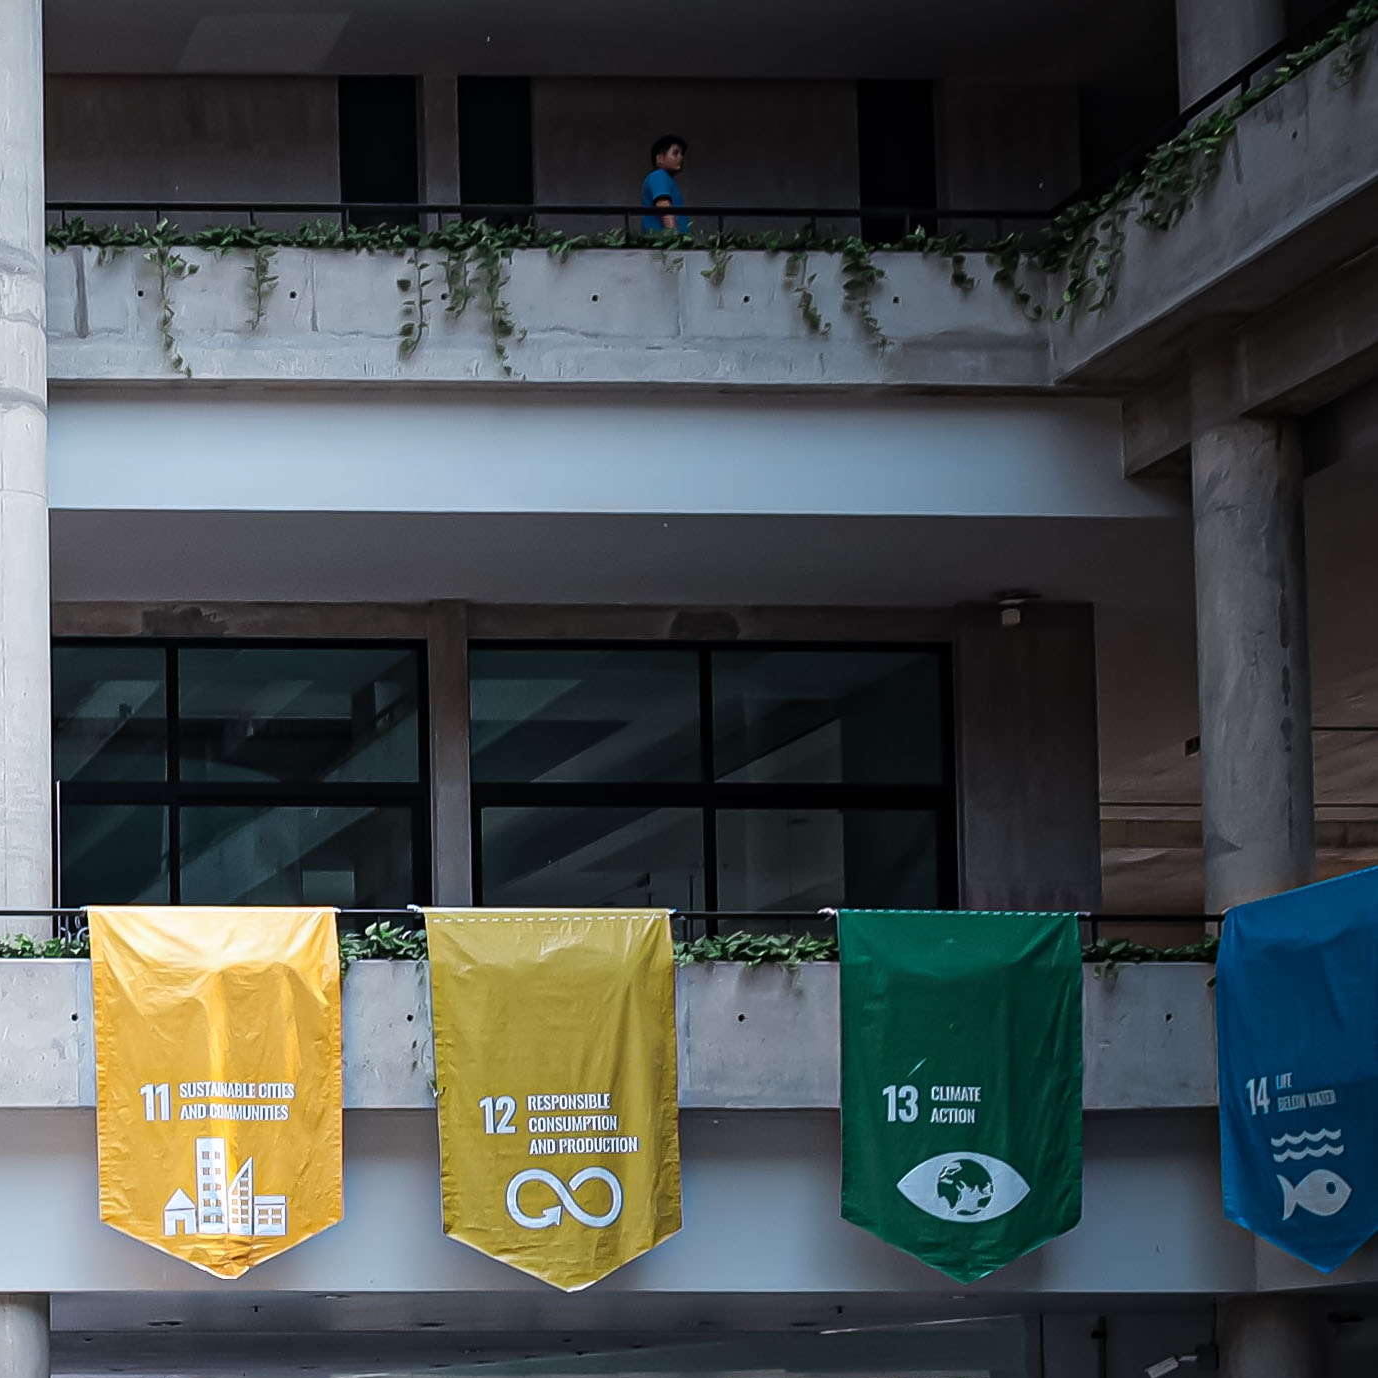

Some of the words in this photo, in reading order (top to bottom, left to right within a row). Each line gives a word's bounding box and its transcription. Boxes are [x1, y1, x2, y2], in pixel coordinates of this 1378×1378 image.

[1275, 1072, 1293, 1090] LIFE
[179, 1082, 256, 1100] SUSTAINABLE
[258, 1082, 295, 1100] CITIES
[931, 1085, 982, 1103] CLIMATE
[1246, 1076, 1271, 1116] 14
[139, 1083, 172, 1121] 11
[527, 1092, 611, 1112] RESPONSIBLE
[882, 1085, 919, 1123] 13
[180, 1104, 207, 1120] AND
[209, 1104, 289, 1121] COMMUNITIES
[478, 1095, 517, 1135] 12
[930, 1107, 976, 1124] ACTION
[528, 1114, 618, 1134] CONSUMPTION
[529, 1138, 556, 1155] AND
[558, 1136, 638, 1154] PRODUCTION
